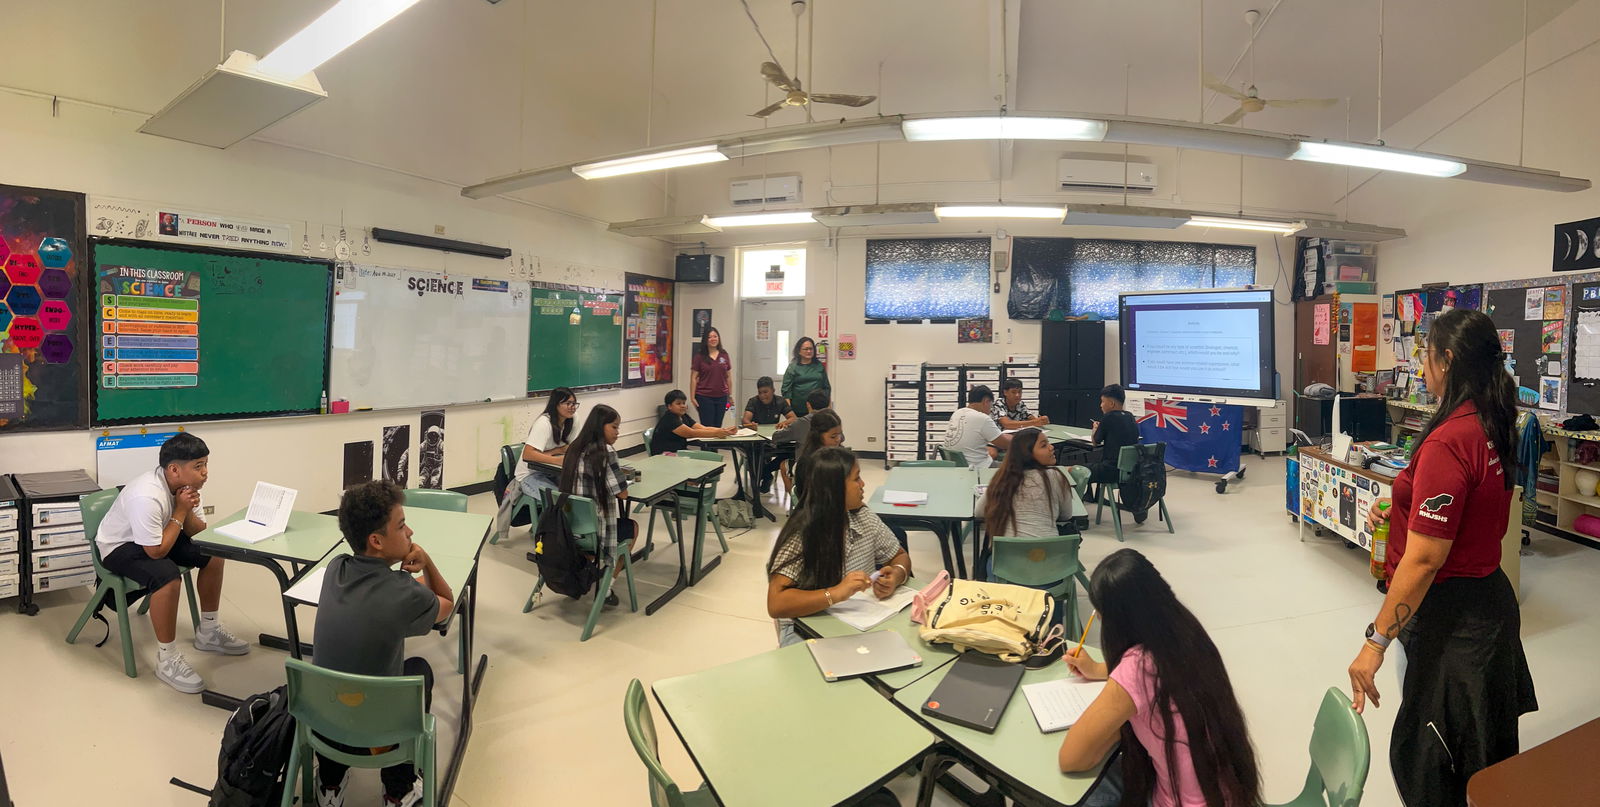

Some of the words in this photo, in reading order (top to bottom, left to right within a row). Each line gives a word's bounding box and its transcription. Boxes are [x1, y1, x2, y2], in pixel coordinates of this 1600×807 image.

[187, 218, 217, 228] PERSON
[250, 226, 265, 234] MADE
[241, 237, 270, 246] ANYTHING
[120, 267, 129, 277] IN
[130, 268, 146, 278] THIS
[146, 270, 184, 280] CLASSROOM
[122, 281, 182, 297] SCIENCE
[407, 277, 464, 295] SCIENCE
[106, 308, 113, 317] C
[106, 363, 113, 371] C
[107, 377, 113, 385] E
